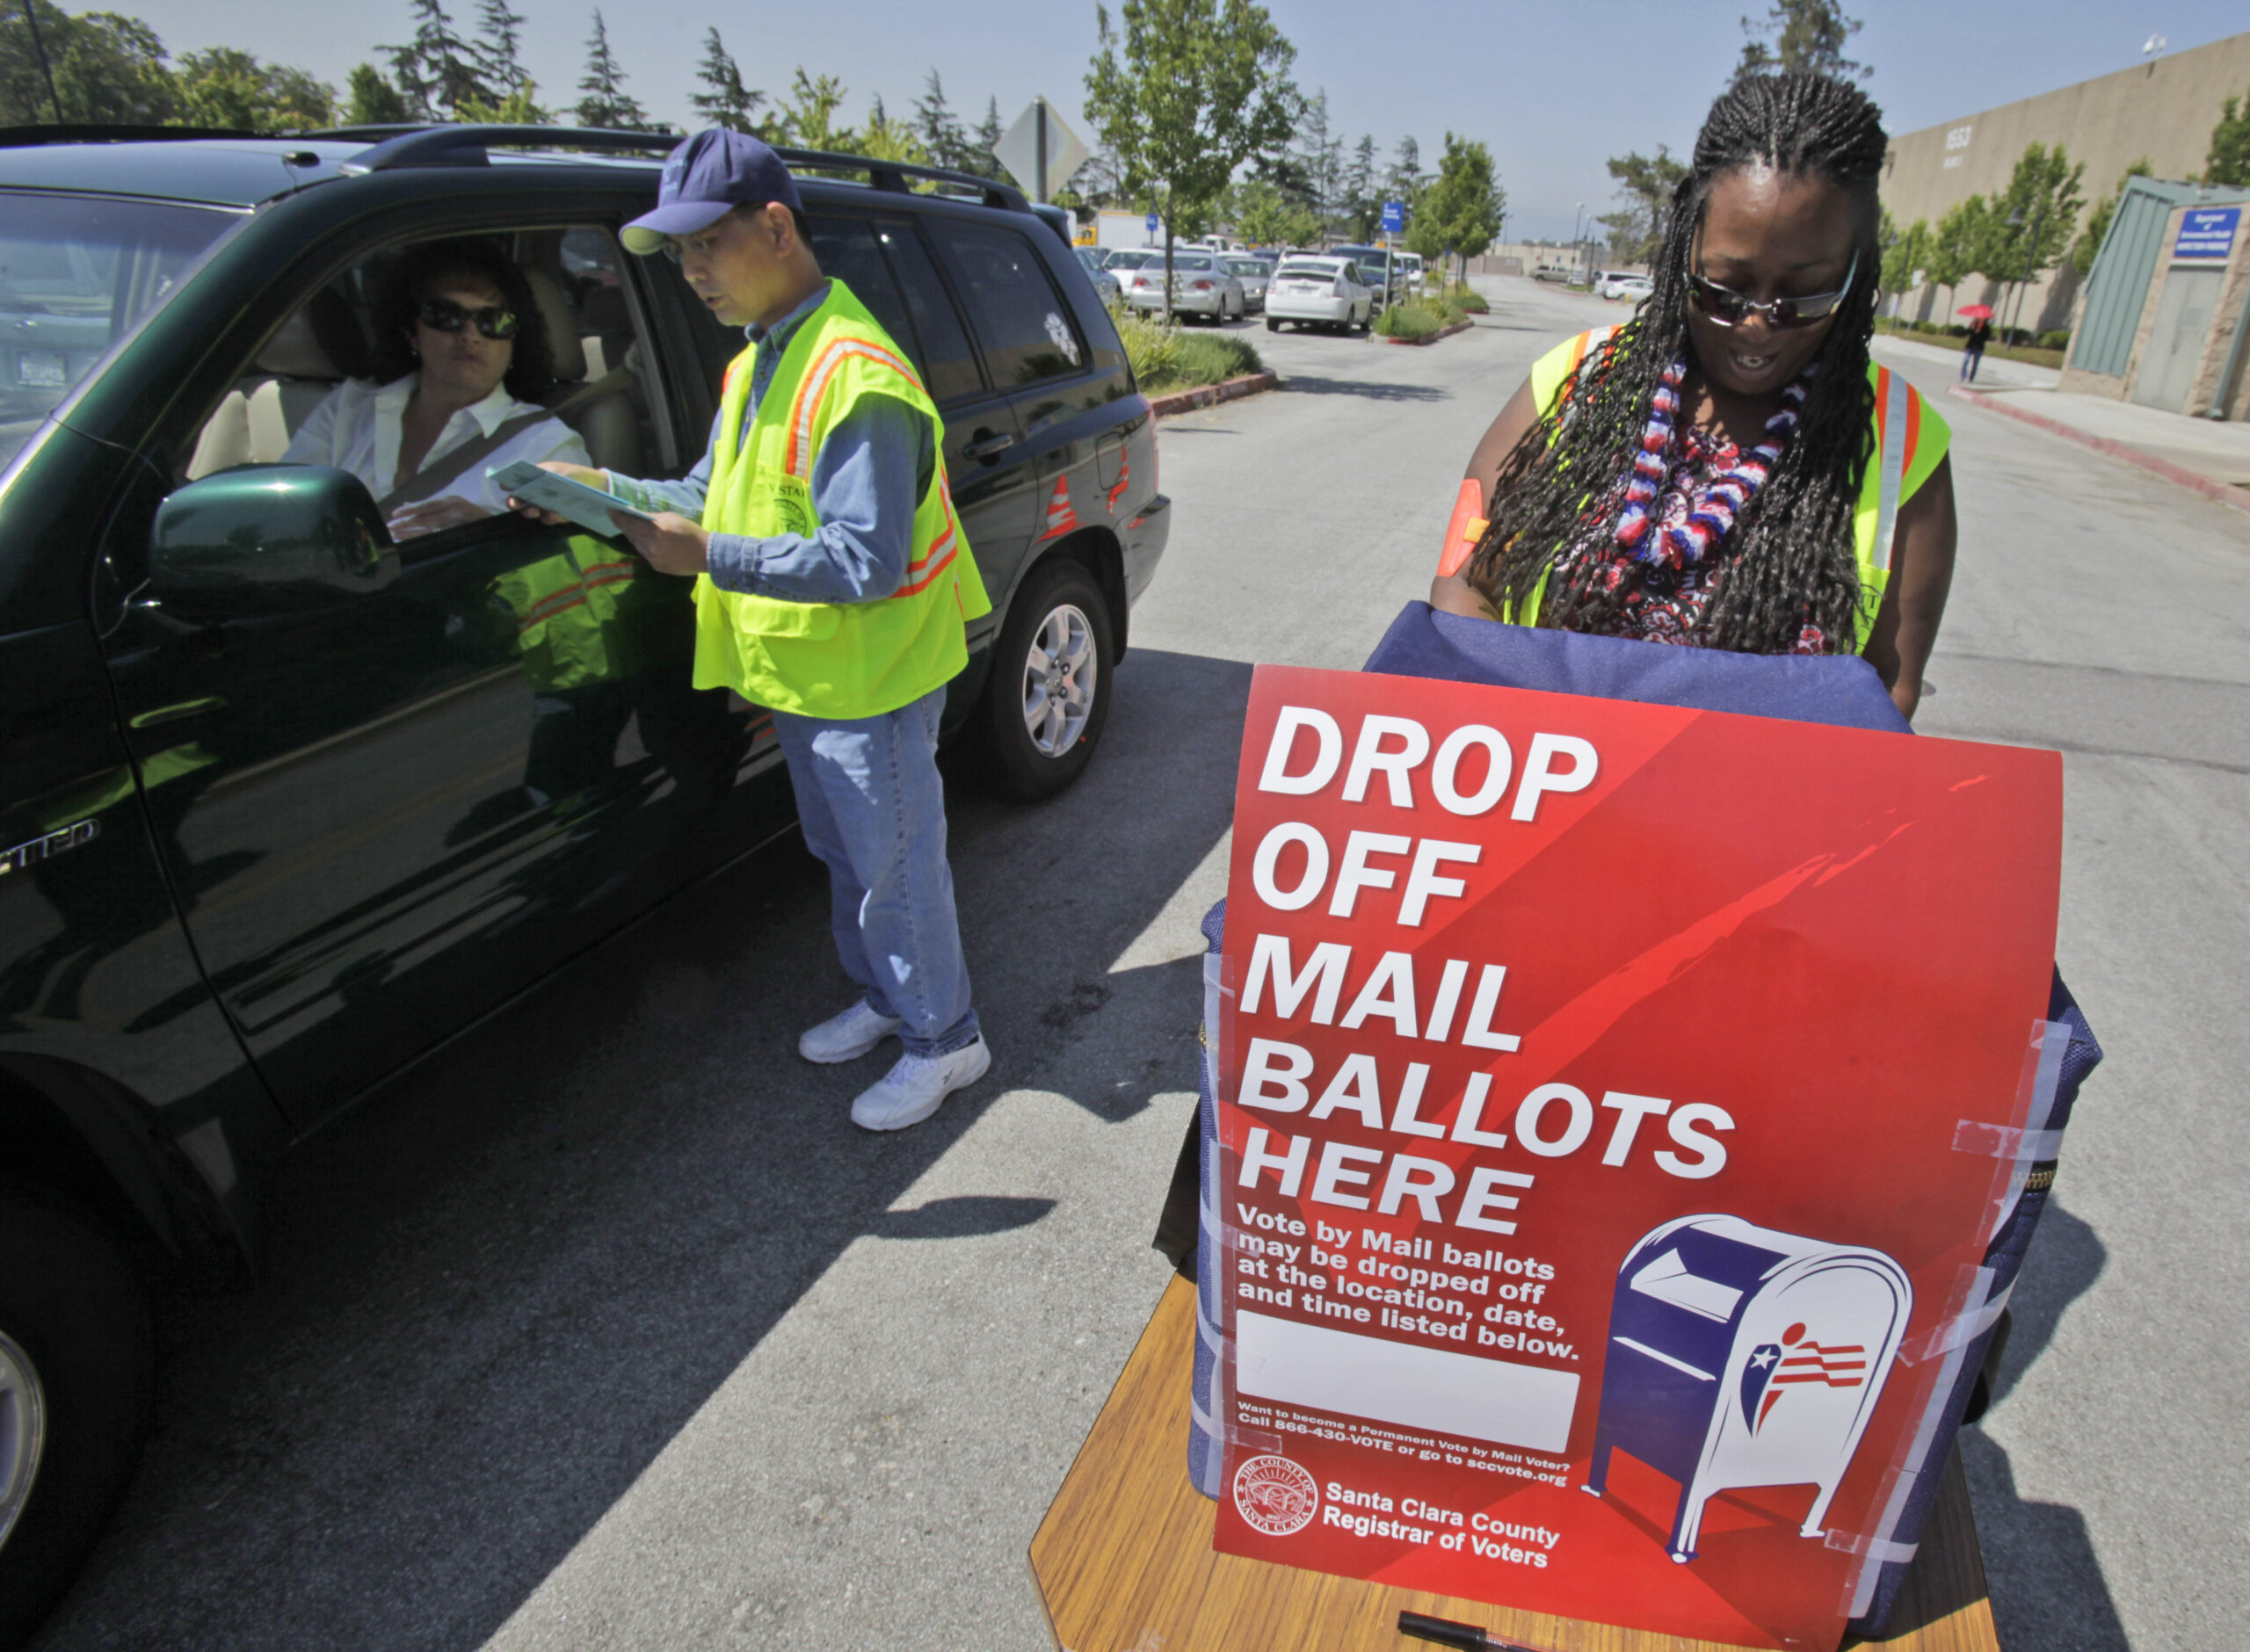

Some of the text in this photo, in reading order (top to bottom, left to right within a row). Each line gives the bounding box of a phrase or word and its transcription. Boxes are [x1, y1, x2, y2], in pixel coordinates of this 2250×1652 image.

[1258, 706, 1599, 822] DROP
[1252, 822, 1482, 927] OFF
[1239, 933, 1521, 1053] MAIL
[1238, 1037, 1736, 1179] BALLOTS
[1238, 1127, 1535, 1236] HERE
[1237, 1202, 1556, 1280] Vote by Mail ballots
[1238, 1233, 1547, 1305] may be dropped off
[1238, 1258, 1565, 1337] at the location, date,
[1238, 1282, 1579, 1360] and time listed below.
[1238, 1401, 1273, 1416] Want
[1275, 1409, 1289, 1419] to
[1293, 1412, 1346, 1430] become
[1361, 1425, 1435, 1446] Permanent
[1438, 1440, 1470, 1453] Vote
[1472, 1446, 1489, 1458] by
[1492, 1450, 1522, 1463] Mail
[1525, 1457, 1571, 1472] Voter?
[1238, 1413, 1568, 1488] Call 866-430-VOTE or go to sccvote.org
[1240, 1461, 1259, 1480] THE
[1260, 1459, 1304, 1478] COUNTY
[1240, 1499, 1310, 1532] SANTA CLARA
[1323, 1505, 1549, 1569] Registrar of Voters
[1325, 1482, 1561, 1550] Santa Clara County
